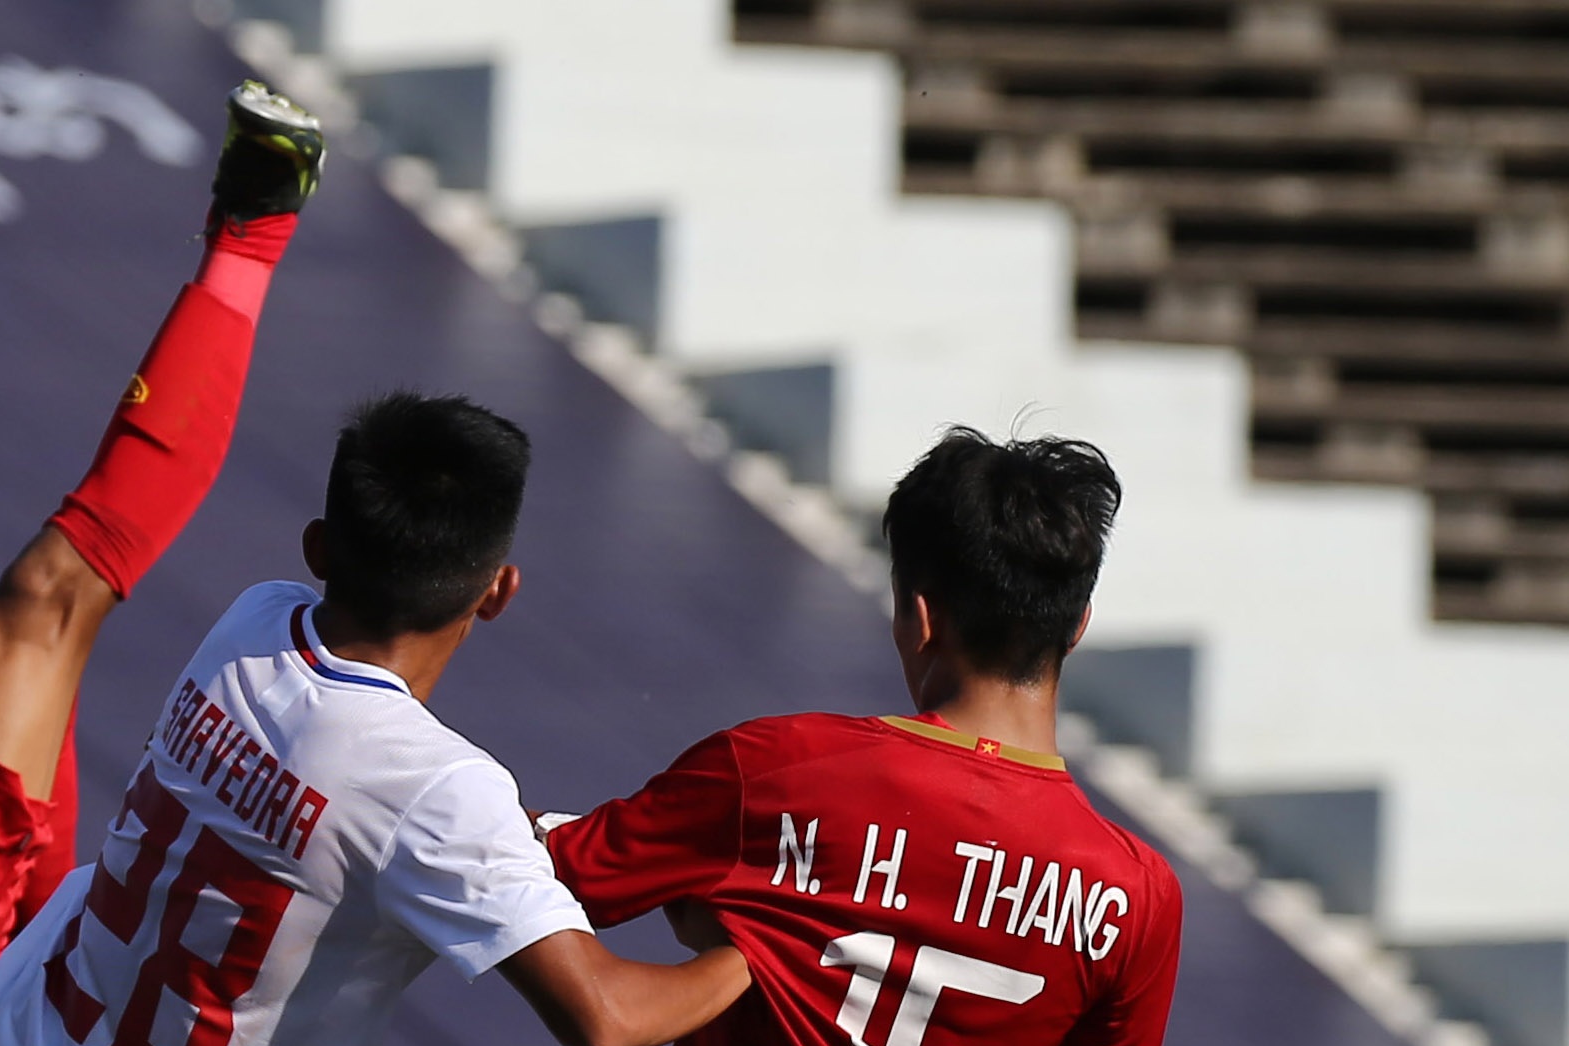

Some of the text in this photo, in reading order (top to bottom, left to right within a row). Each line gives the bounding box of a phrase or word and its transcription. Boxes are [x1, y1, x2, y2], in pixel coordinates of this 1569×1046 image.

[159, 677, 329, 861] SAAVEDRA
[770, 812, 1130, 961] N. H. THANG
